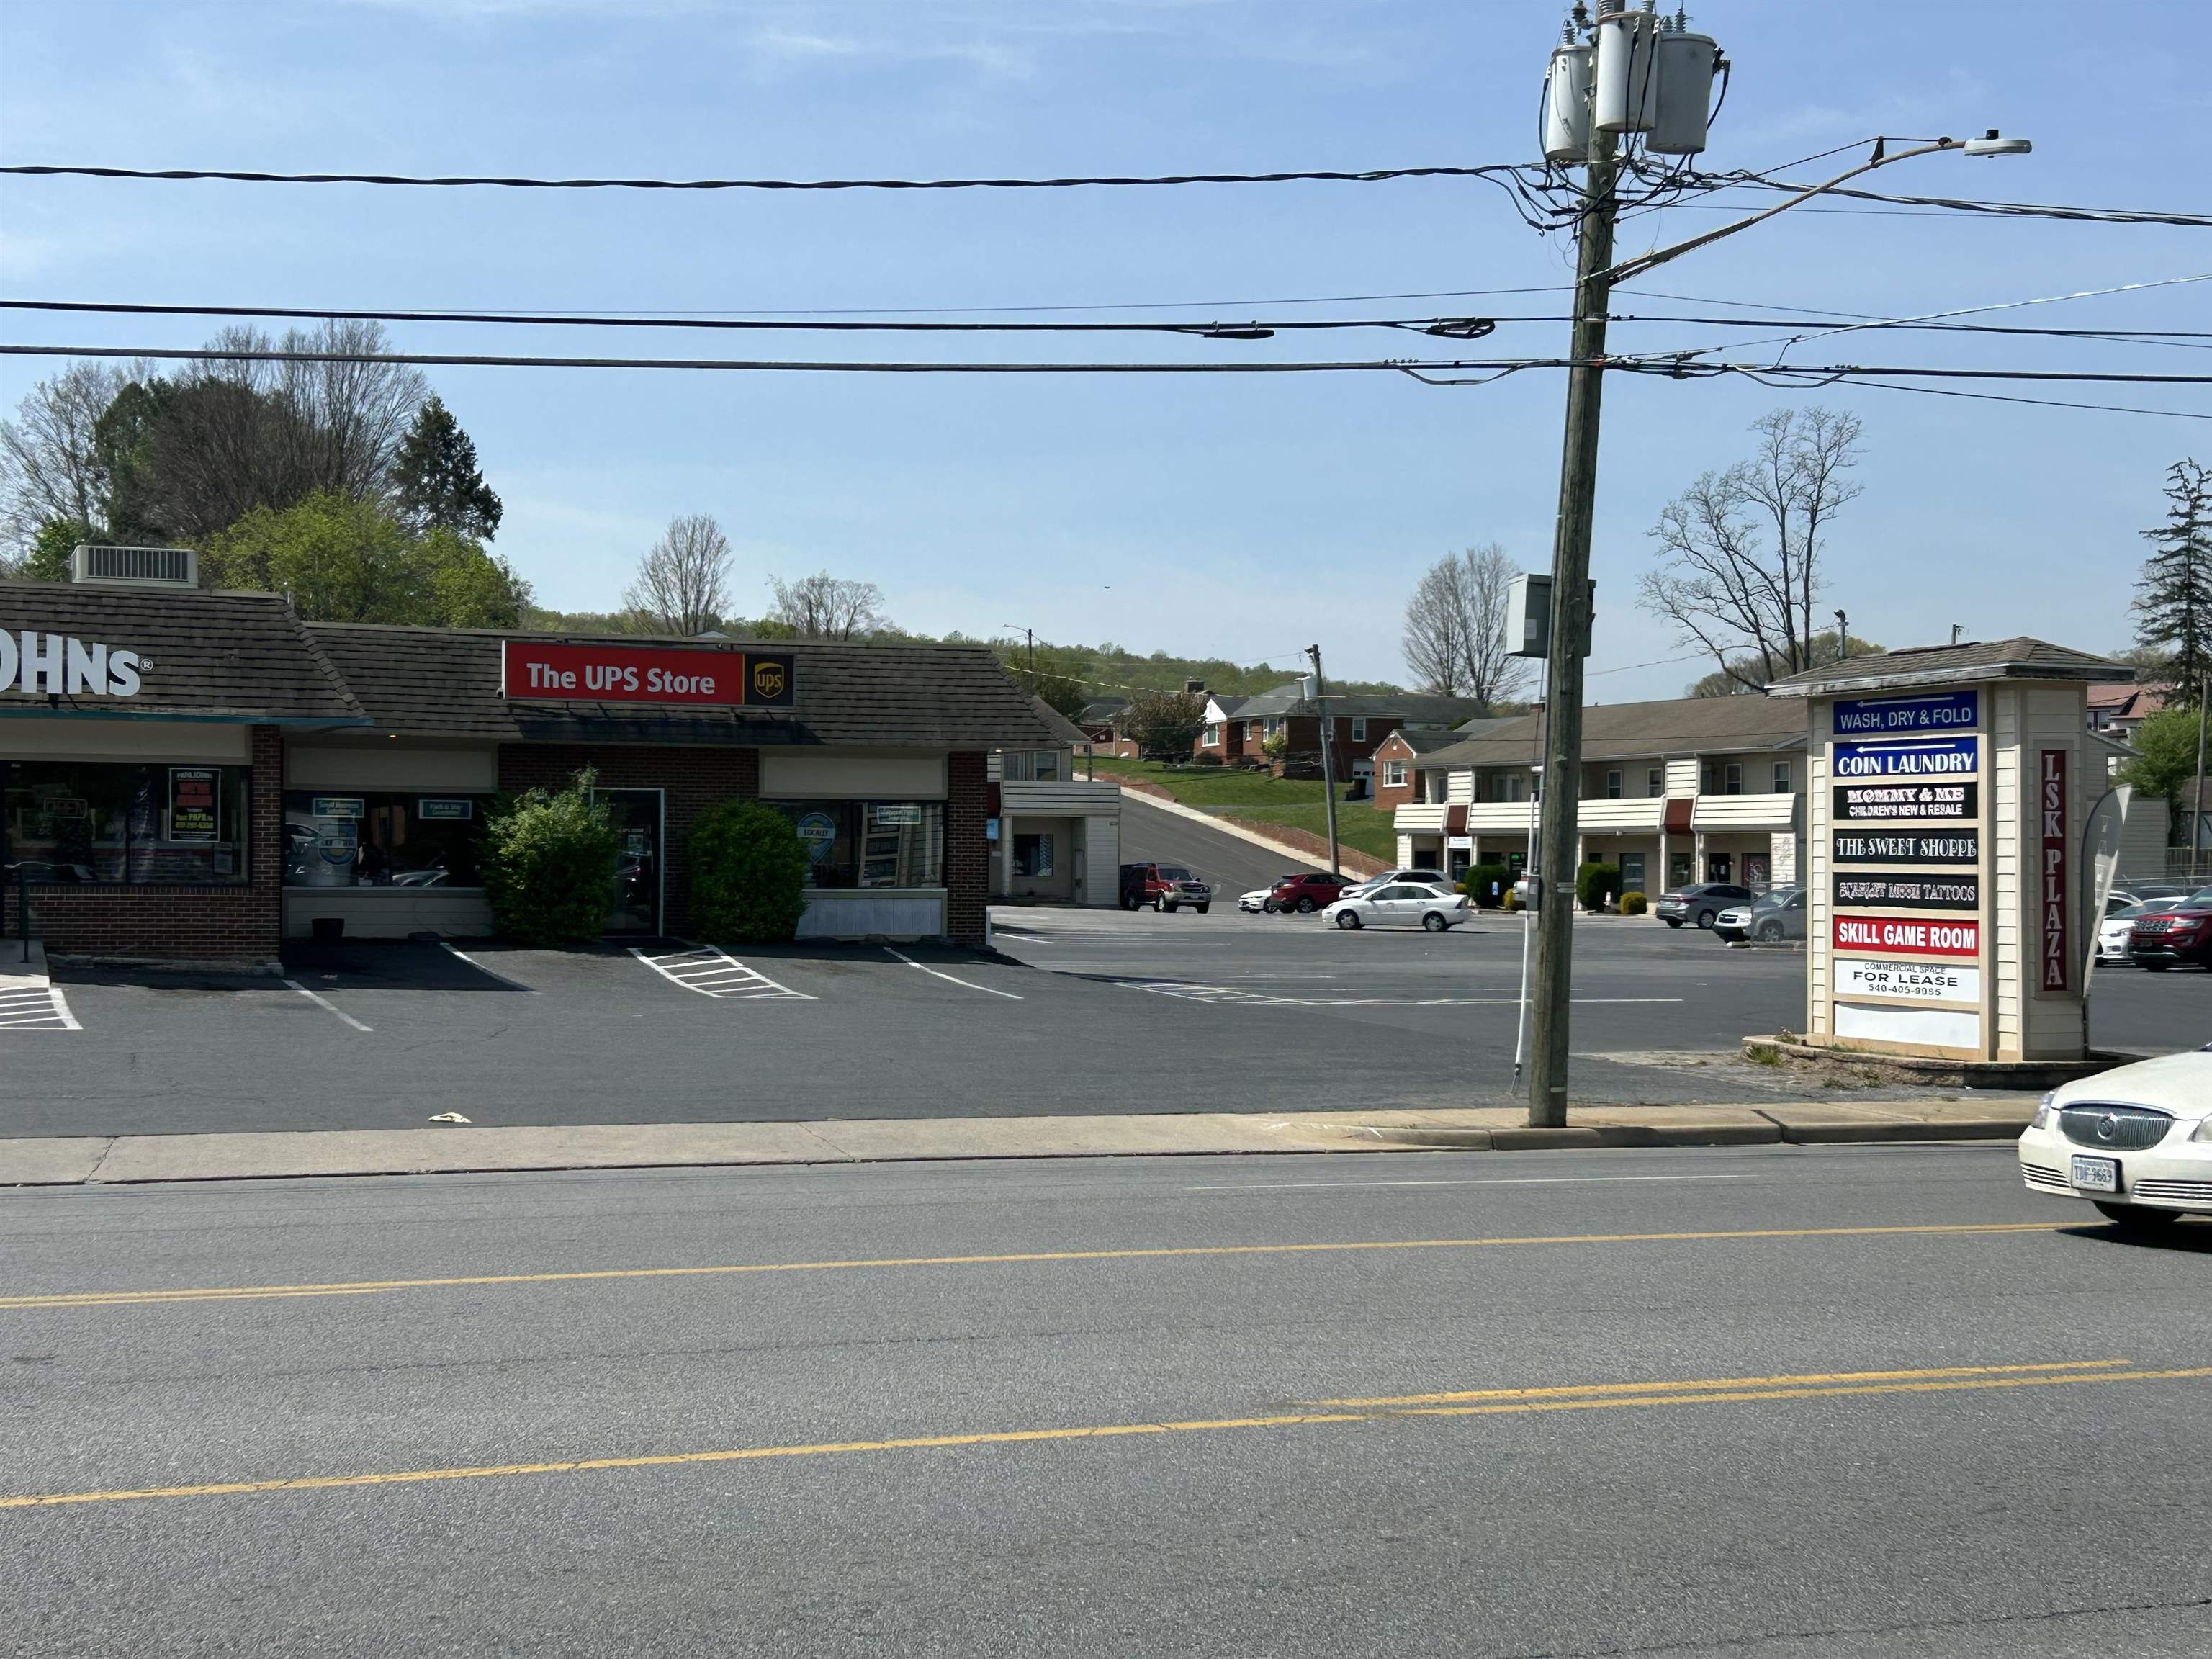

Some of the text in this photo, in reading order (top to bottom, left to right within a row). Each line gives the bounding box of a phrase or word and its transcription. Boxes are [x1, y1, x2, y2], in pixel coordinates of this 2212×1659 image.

[526, 662, 715, 695] The UPS Store
[757, 673, 782, 693] ups
[1840, 707, 1972, 729] WASH, DRY & FOLD
[1838, 752, 1974, 775] COIN LAUNDRY
[1847, 787, 1964, 803] MOMMY & ME
[1849, 804, 1963, 817] CHILDREN'S NEW & RESALE
[1836, 837, 1977, 857] THE SWEET SHOPPE
[2043, 755, 2064, 985] LSK PLAZA
[1923, 884, 1976, 901] TATTOOS
[1839, 922, 1975, 949] SKILL GAME ROOM
[1853, 971, 1959, 986] FOR LEASE
